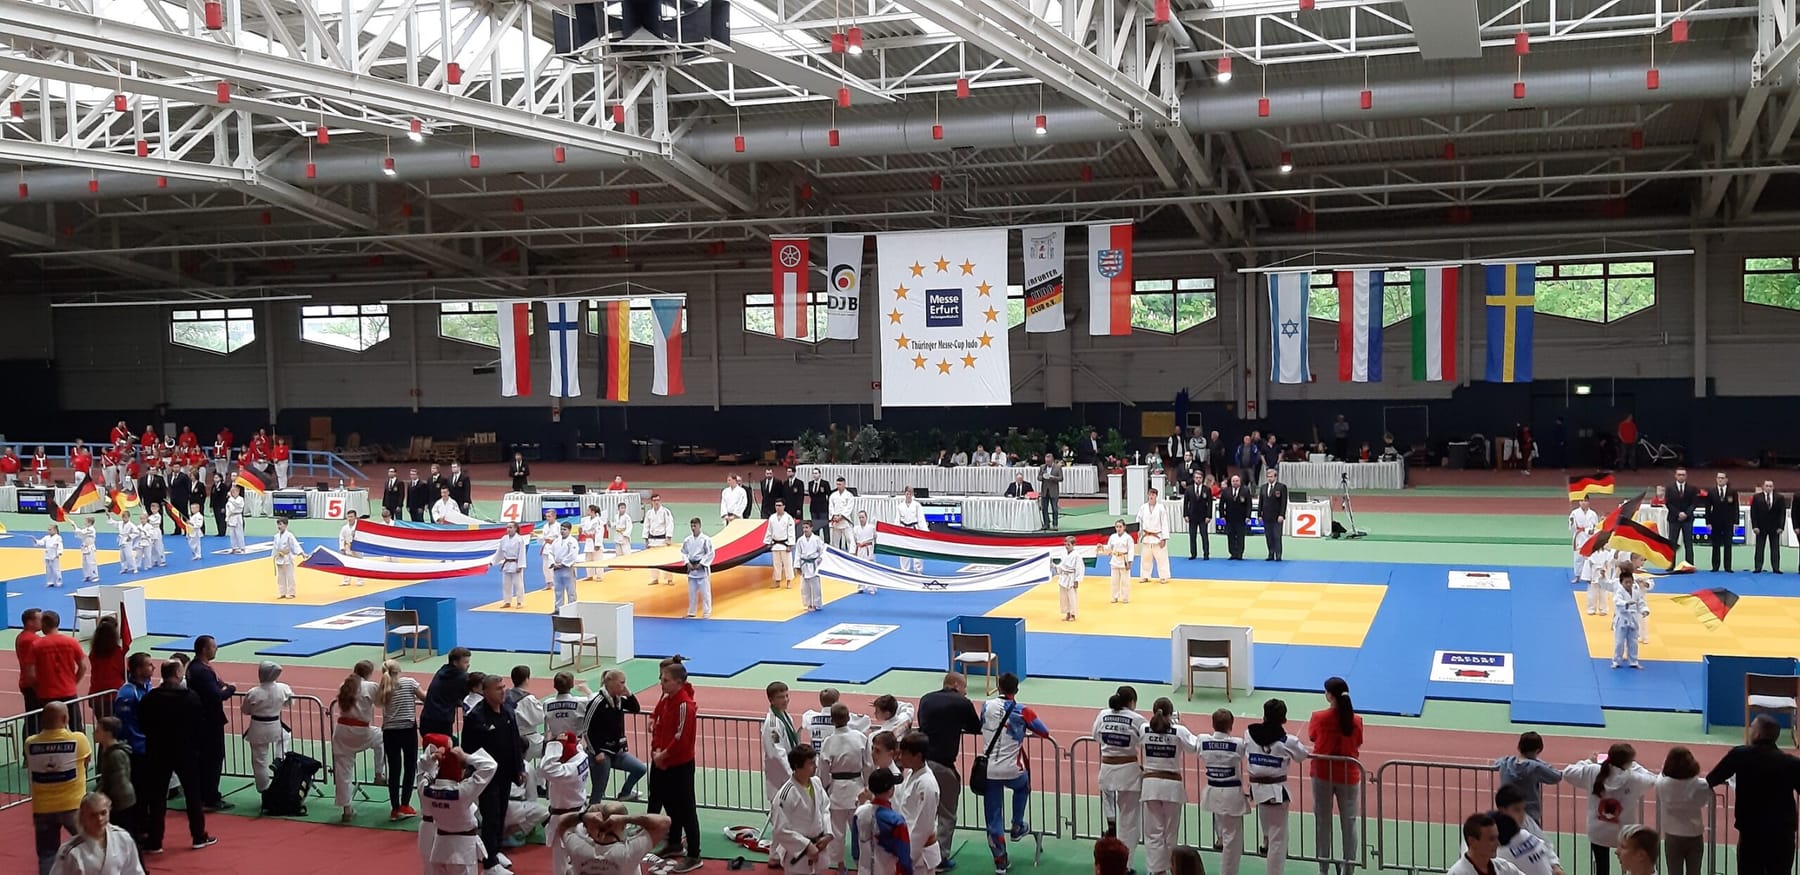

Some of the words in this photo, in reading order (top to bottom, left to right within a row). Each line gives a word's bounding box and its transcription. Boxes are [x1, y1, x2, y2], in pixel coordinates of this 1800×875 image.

[1027, 268, 1058, 287] ERFURTER
[828, 295, 858, 311] DJB
[929, 294, 959, 304] Messe
[930, 305, 959, 315] Erfurt
[1030, 303, 1045, 315] CLUB
[911, 340, 937, 351] Thüringer
[938, 339, 964, 351] Messe-Cup
[965, 339, 978, 349] Judo
[328, 500, 342, 518] 5
[503, 503, 520, 521] 4
[1296, 513, 1317, 536] 2
[555, 711, 569, 719] CZE
[1148, 735, 1164, 743] CZE
